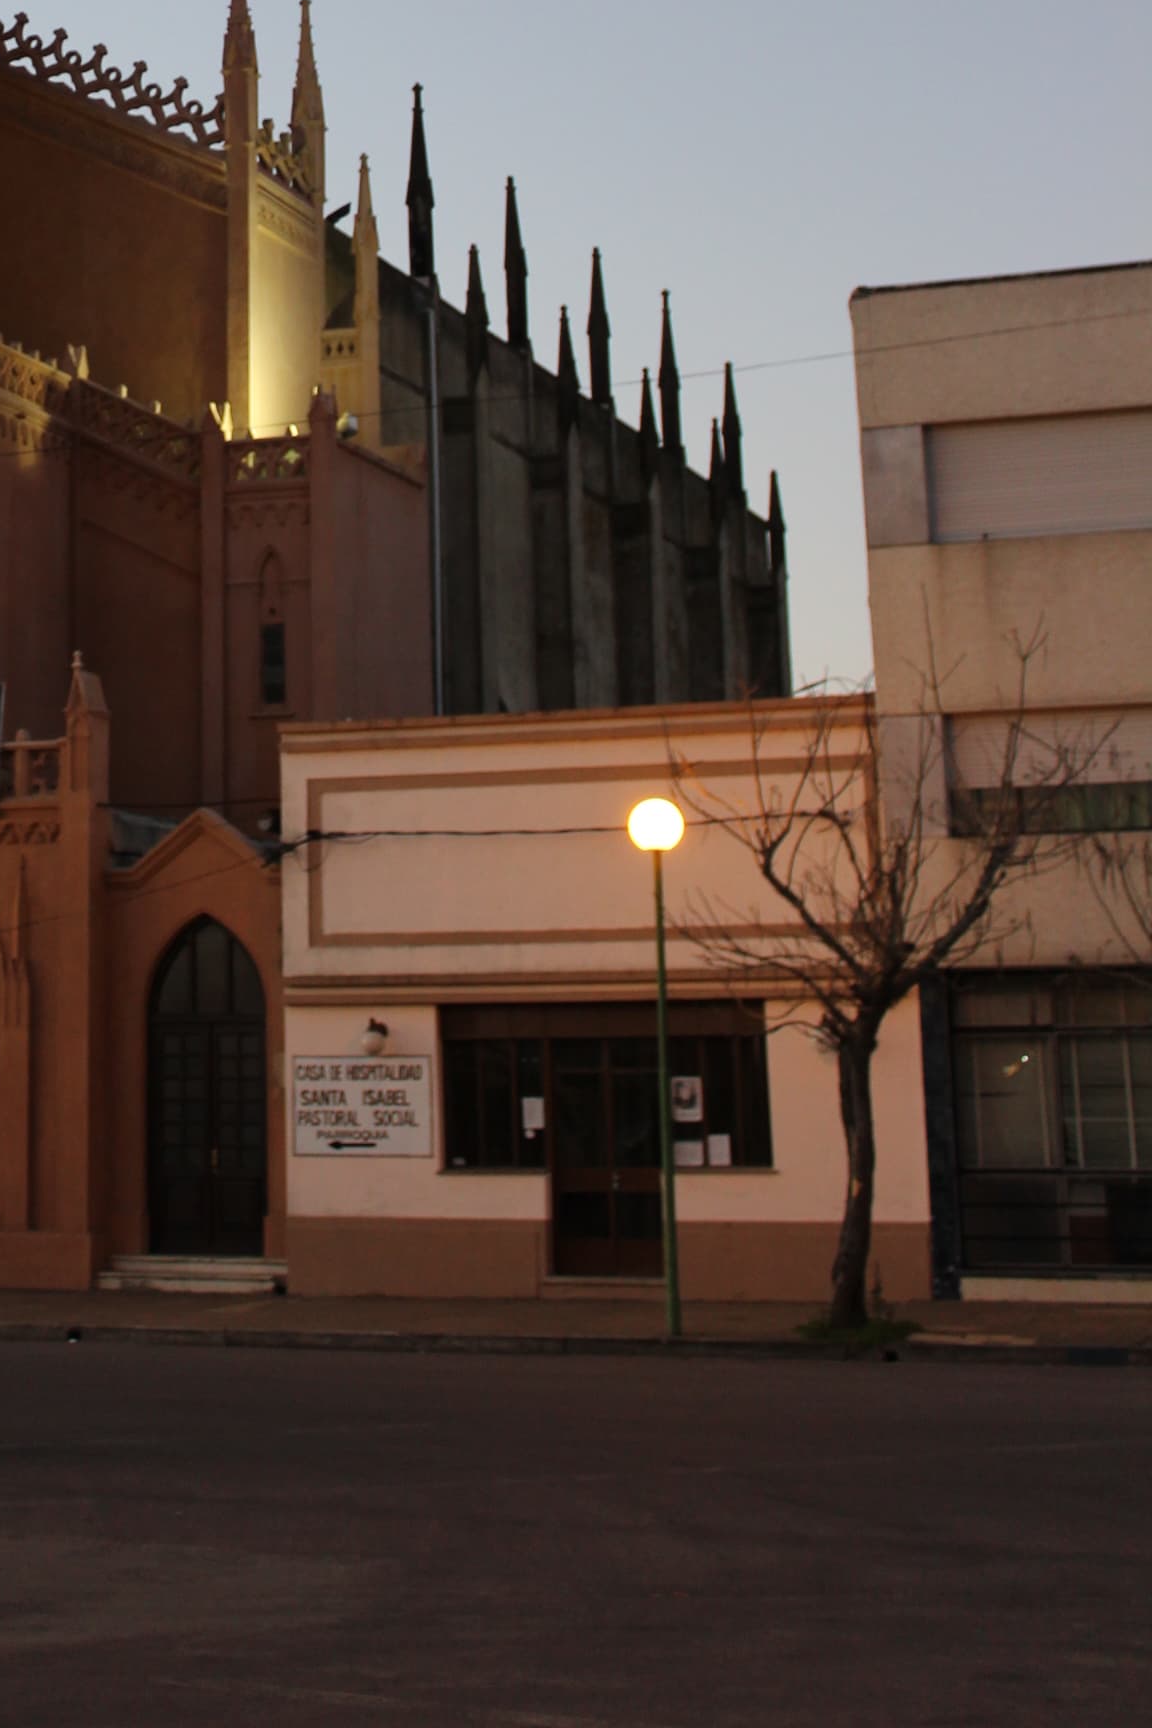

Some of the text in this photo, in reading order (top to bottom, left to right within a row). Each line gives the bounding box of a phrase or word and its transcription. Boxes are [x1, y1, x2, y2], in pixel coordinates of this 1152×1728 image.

[296, 1064, 423, 1080] CASA DE HOSPITALIDAD
[300, 1089, 410, 1106] SANTA ISABEL
[297, 1110, 419, 1127] PASTORAL SOCIAL
[316, 1130, 389, 1141] PARROQUIA
